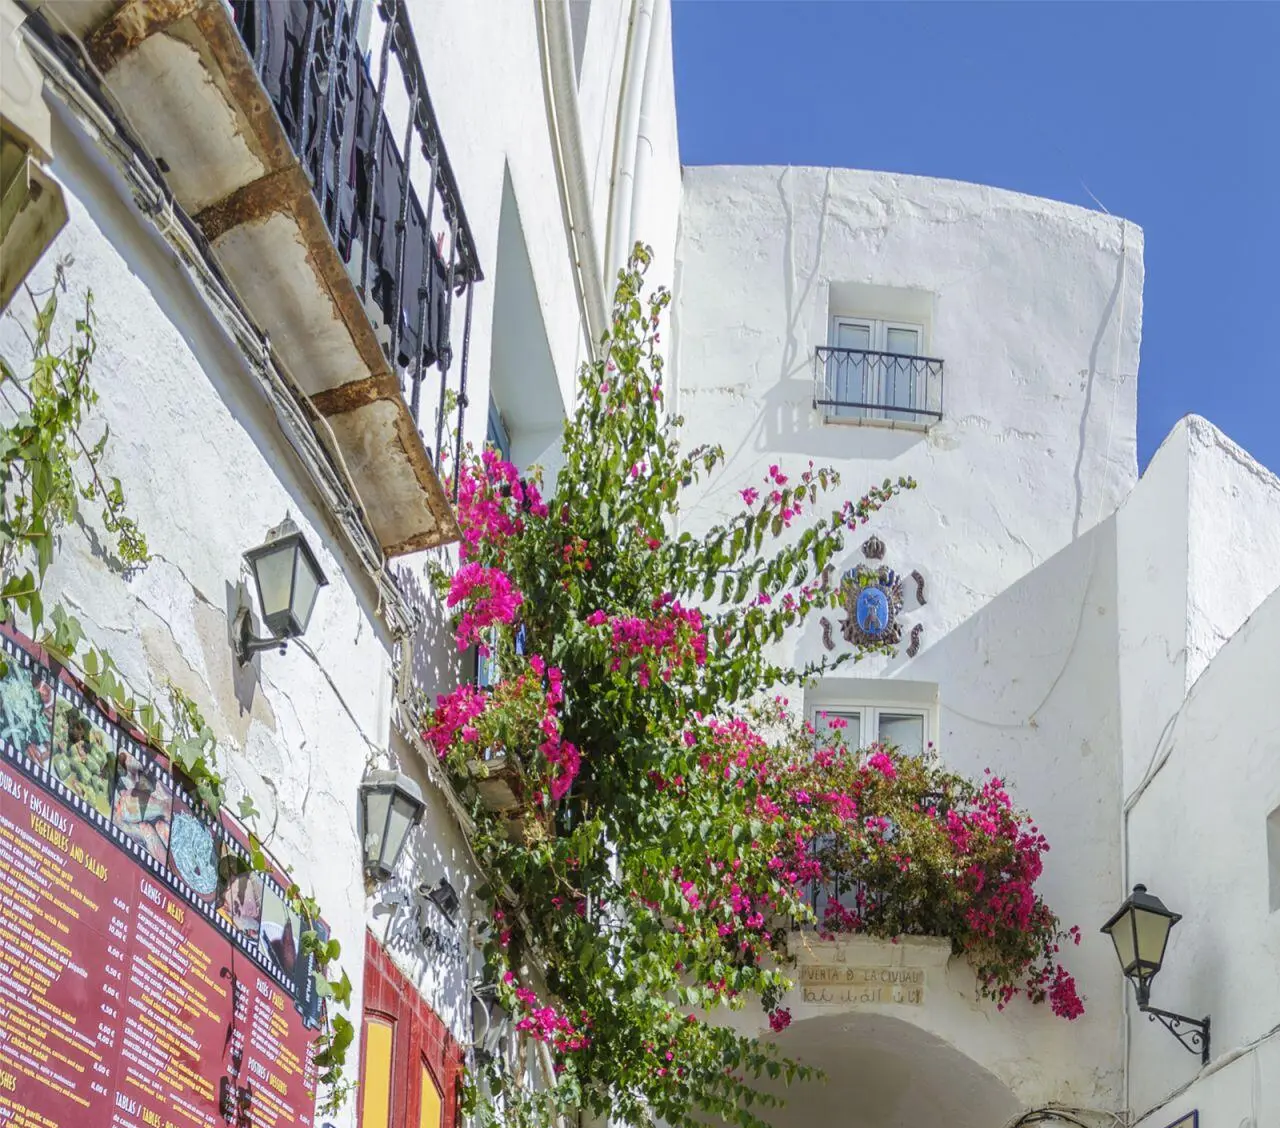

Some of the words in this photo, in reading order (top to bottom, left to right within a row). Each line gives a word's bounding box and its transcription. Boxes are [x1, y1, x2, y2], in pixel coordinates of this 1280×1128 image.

[30, 792, 67, 835] ENSALADAS
[29, 810, 69, 855] VEGETABLES
[69, 841, 84, 866] AND
[84, 852, 109, 884] SALADS
[166, 898, 184, 925] MEATS
[115, 1090, 136, 1115] TABLAS
